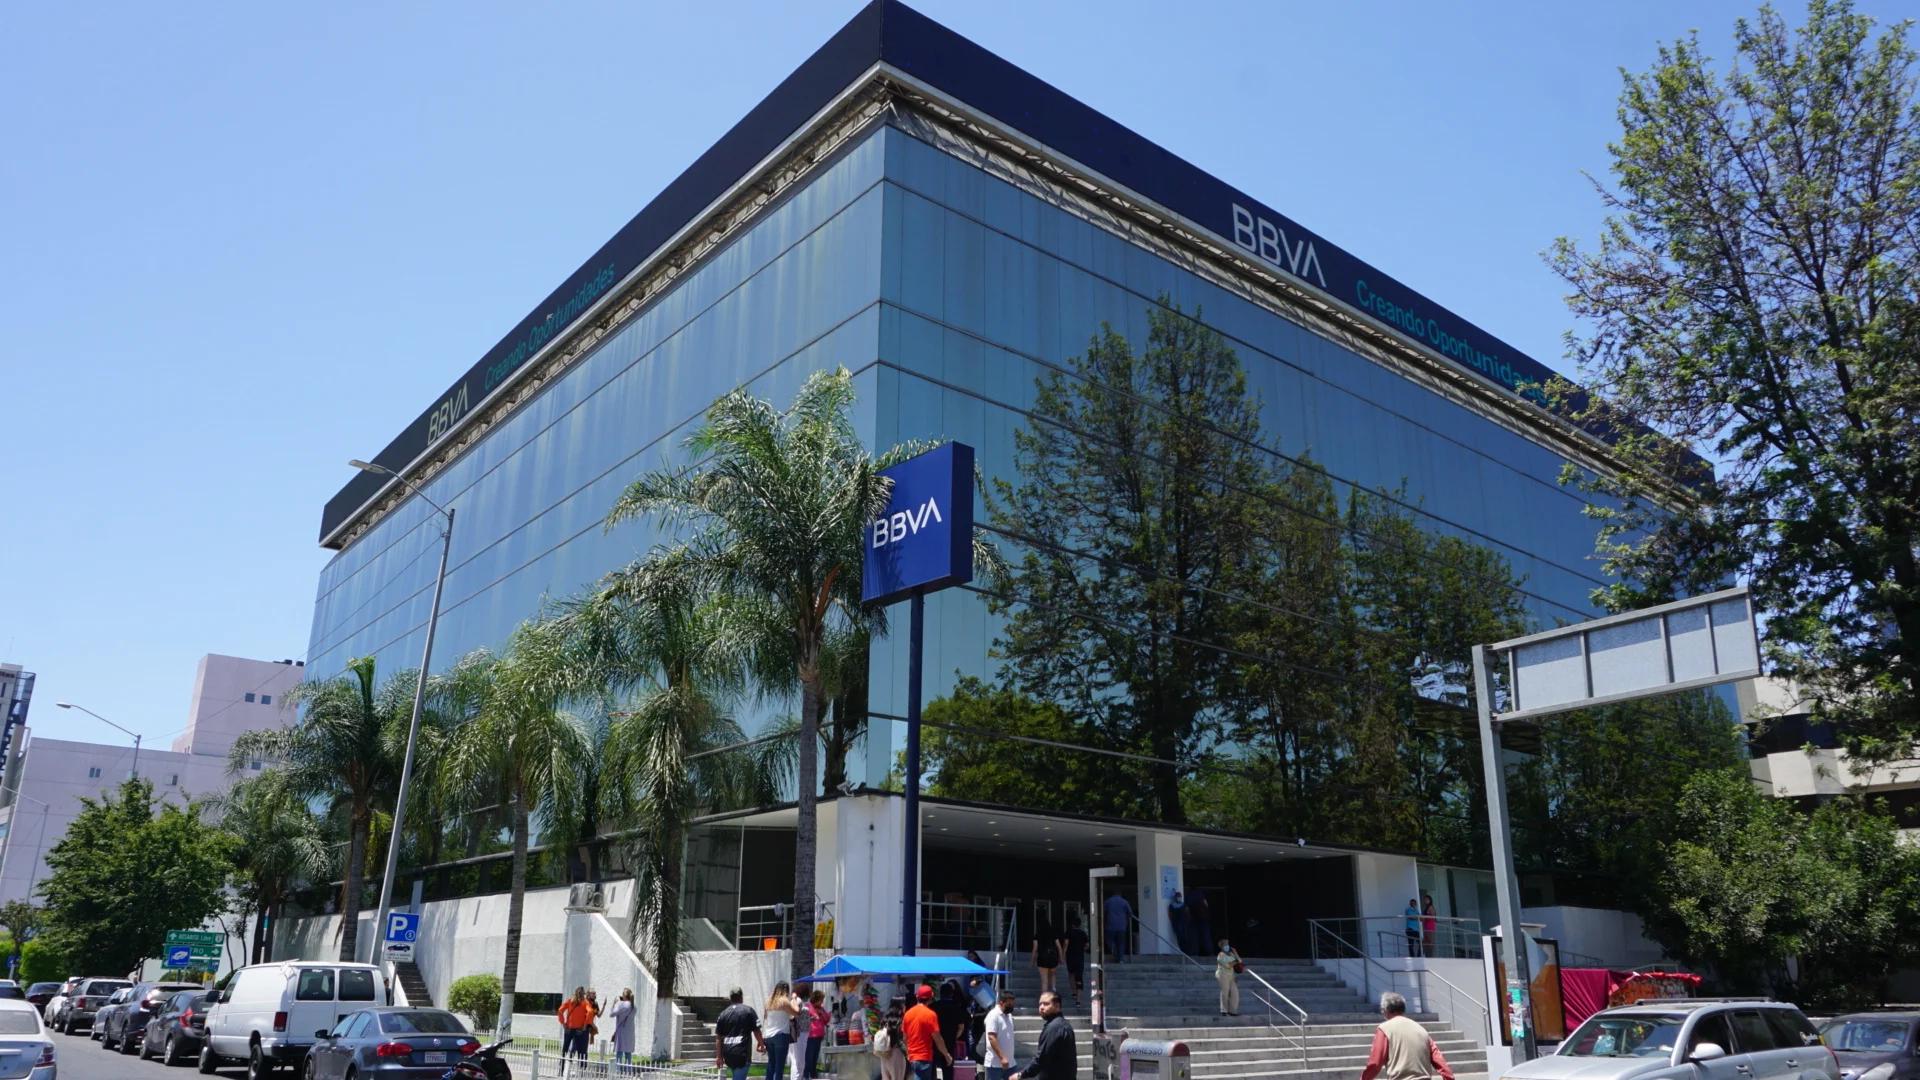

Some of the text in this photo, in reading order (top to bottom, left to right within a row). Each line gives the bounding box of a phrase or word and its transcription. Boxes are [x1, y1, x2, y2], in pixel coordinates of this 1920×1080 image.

[1232, 202, 1327, 288] BBVA
[484, 263, 614, 390] Creando Oportunidades
[1356, 279, 1425, 337] Creando
[427, 381, 468, 446] BBVA
[873, 496, 942, 549] BBVA
[390, 916, 408, 938] P
